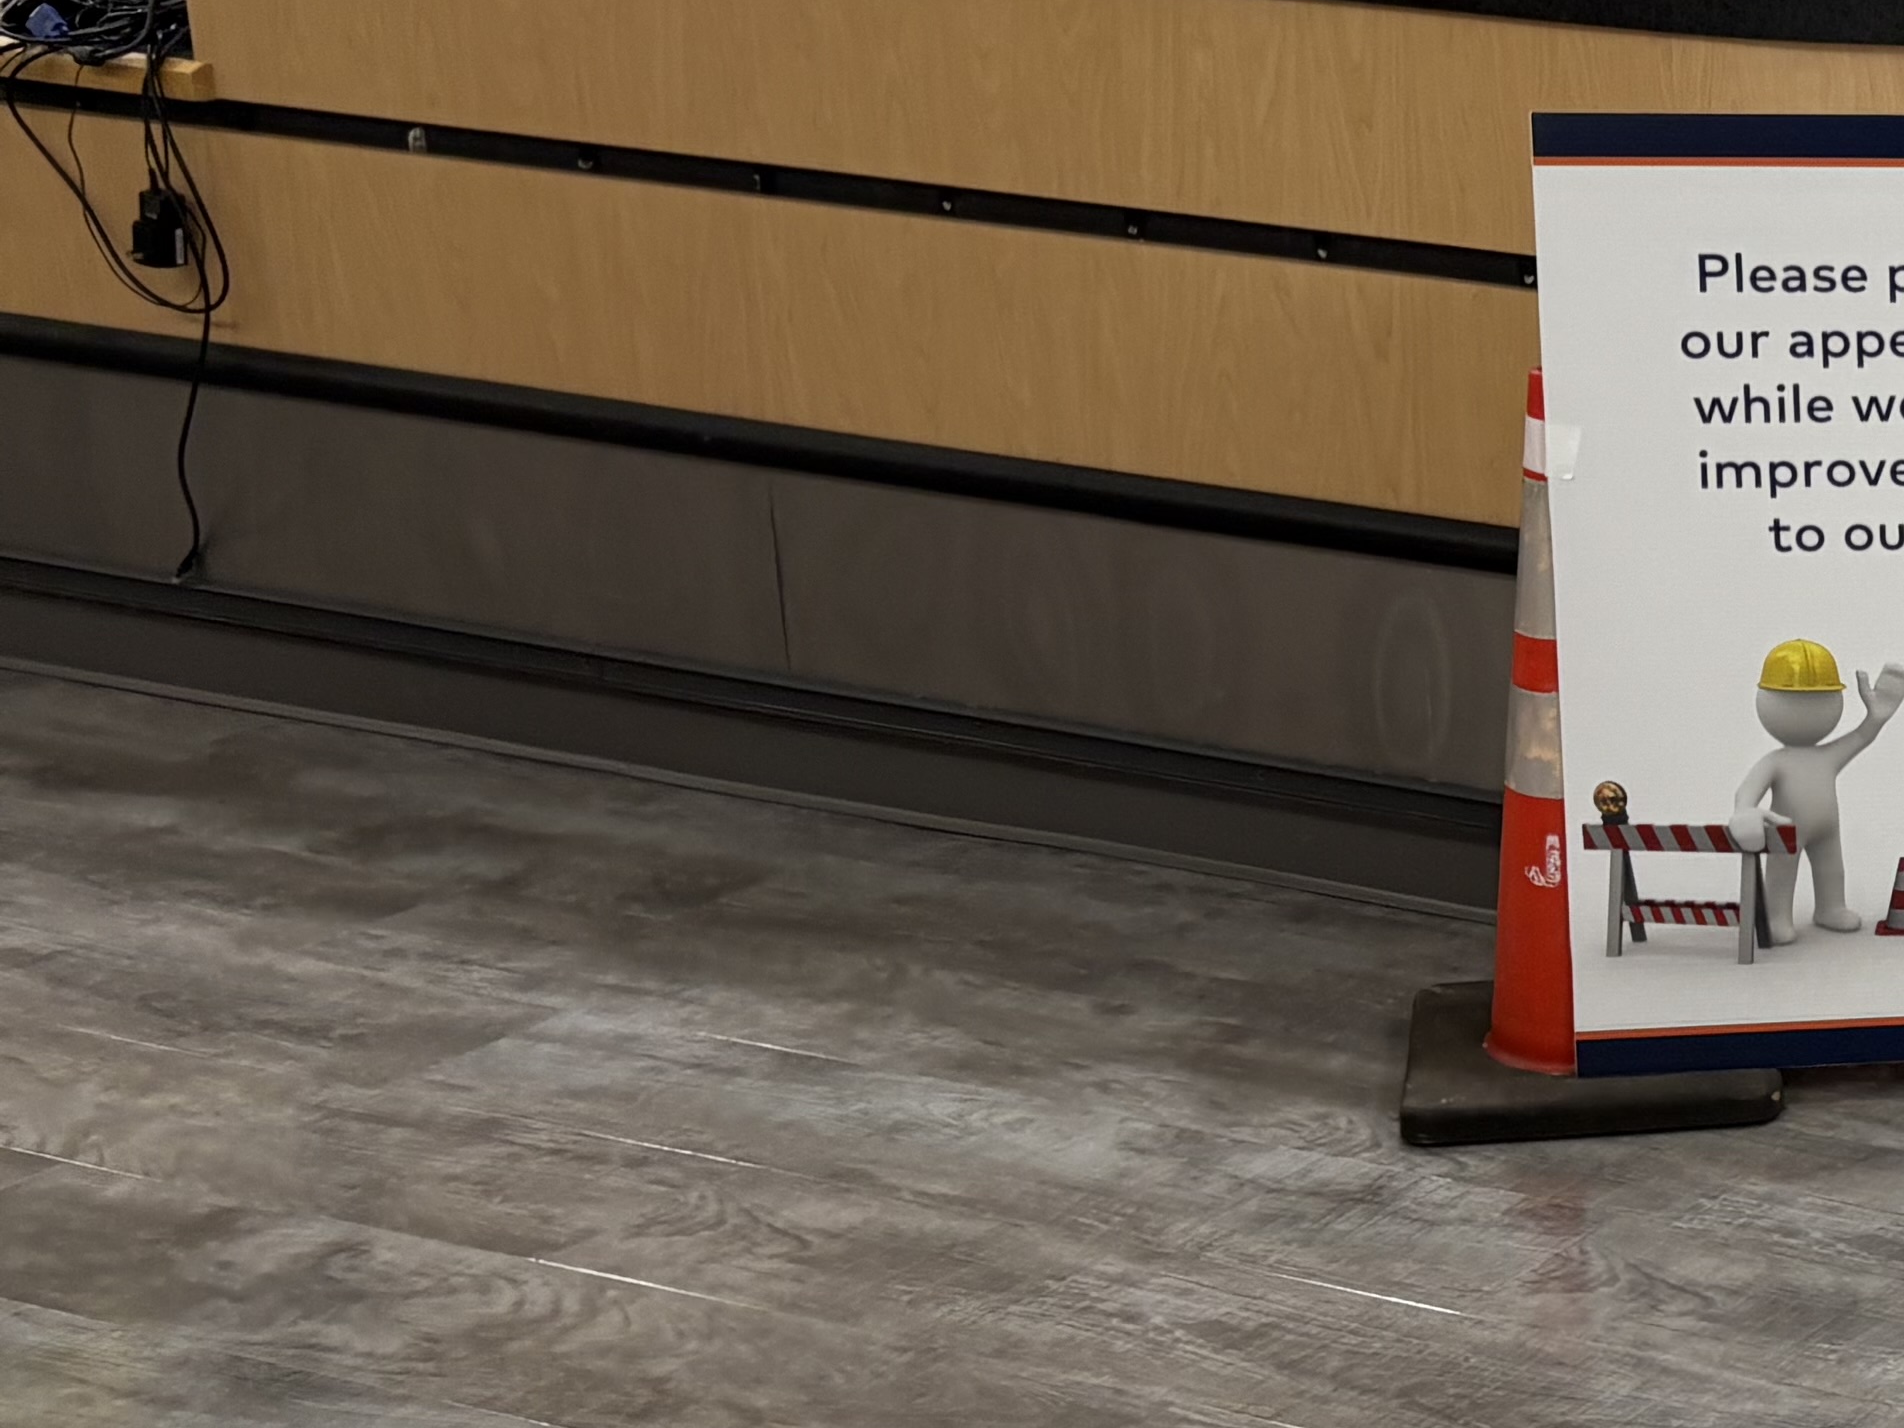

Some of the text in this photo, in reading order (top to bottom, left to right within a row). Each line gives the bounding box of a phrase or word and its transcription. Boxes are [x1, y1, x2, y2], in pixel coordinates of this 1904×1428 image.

[1697, 252, 1868, 294] Please
[1680, 330, 1770, 360] our
[1693, 382, 1834, 425] while
[1768, 517, 1825, 553] to
